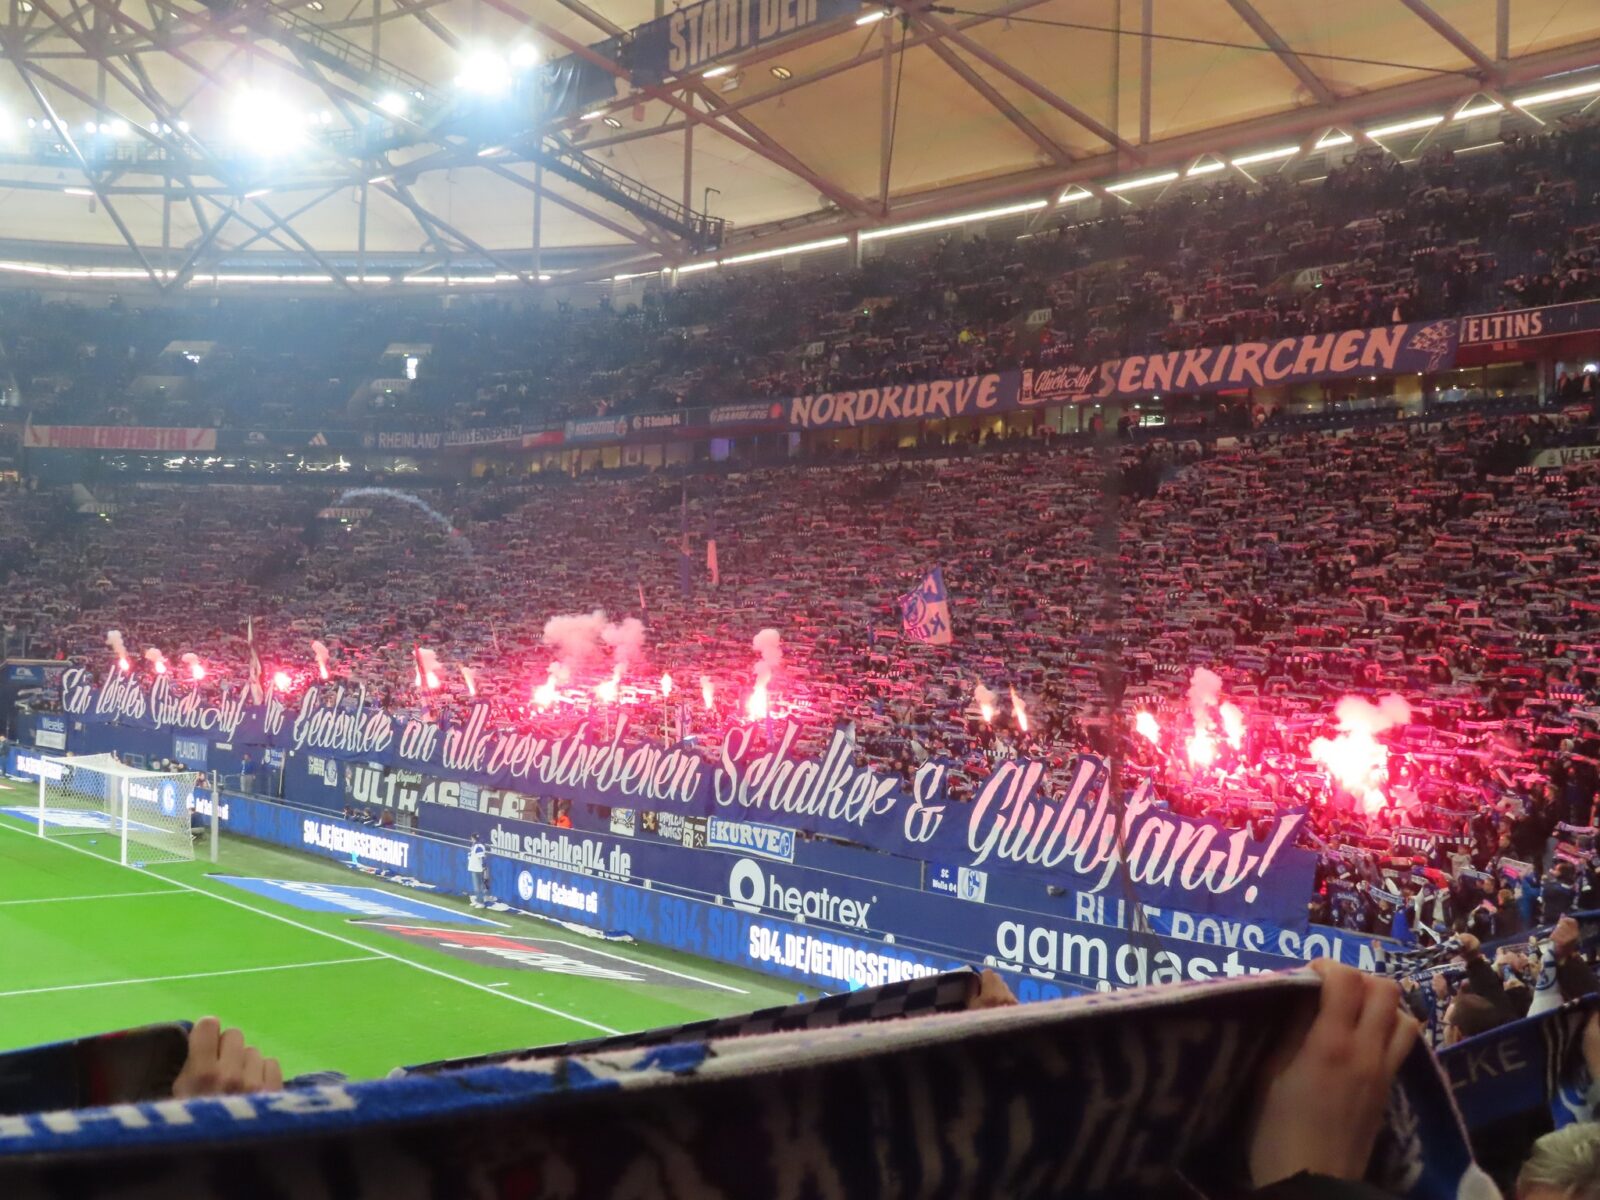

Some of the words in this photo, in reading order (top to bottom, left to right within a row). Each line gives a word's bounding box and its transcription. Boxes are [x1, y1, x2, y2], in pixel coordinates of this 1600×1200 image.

[1017, 325, 1408, 404] SENKIRCHEN
[790, 374, 1000, 428] NORDKURVE
[378, 432, 441, 449] RHEINLAND
[62, 667, 92, 714] Ein
[96, 665, 146, 721] letztes
[293, 683, 394, 752] Gedenken
[400, 719, 437, 762] an
[443, 704, 490, 772] alle
[714, 720, 898, 827] Schalker
[904, 762, 946, 842] &
[716, 820, 781, 854] KURVE
[552, 882, 585, 911] Schalke
[770, 875, 870, 929] heatrex
